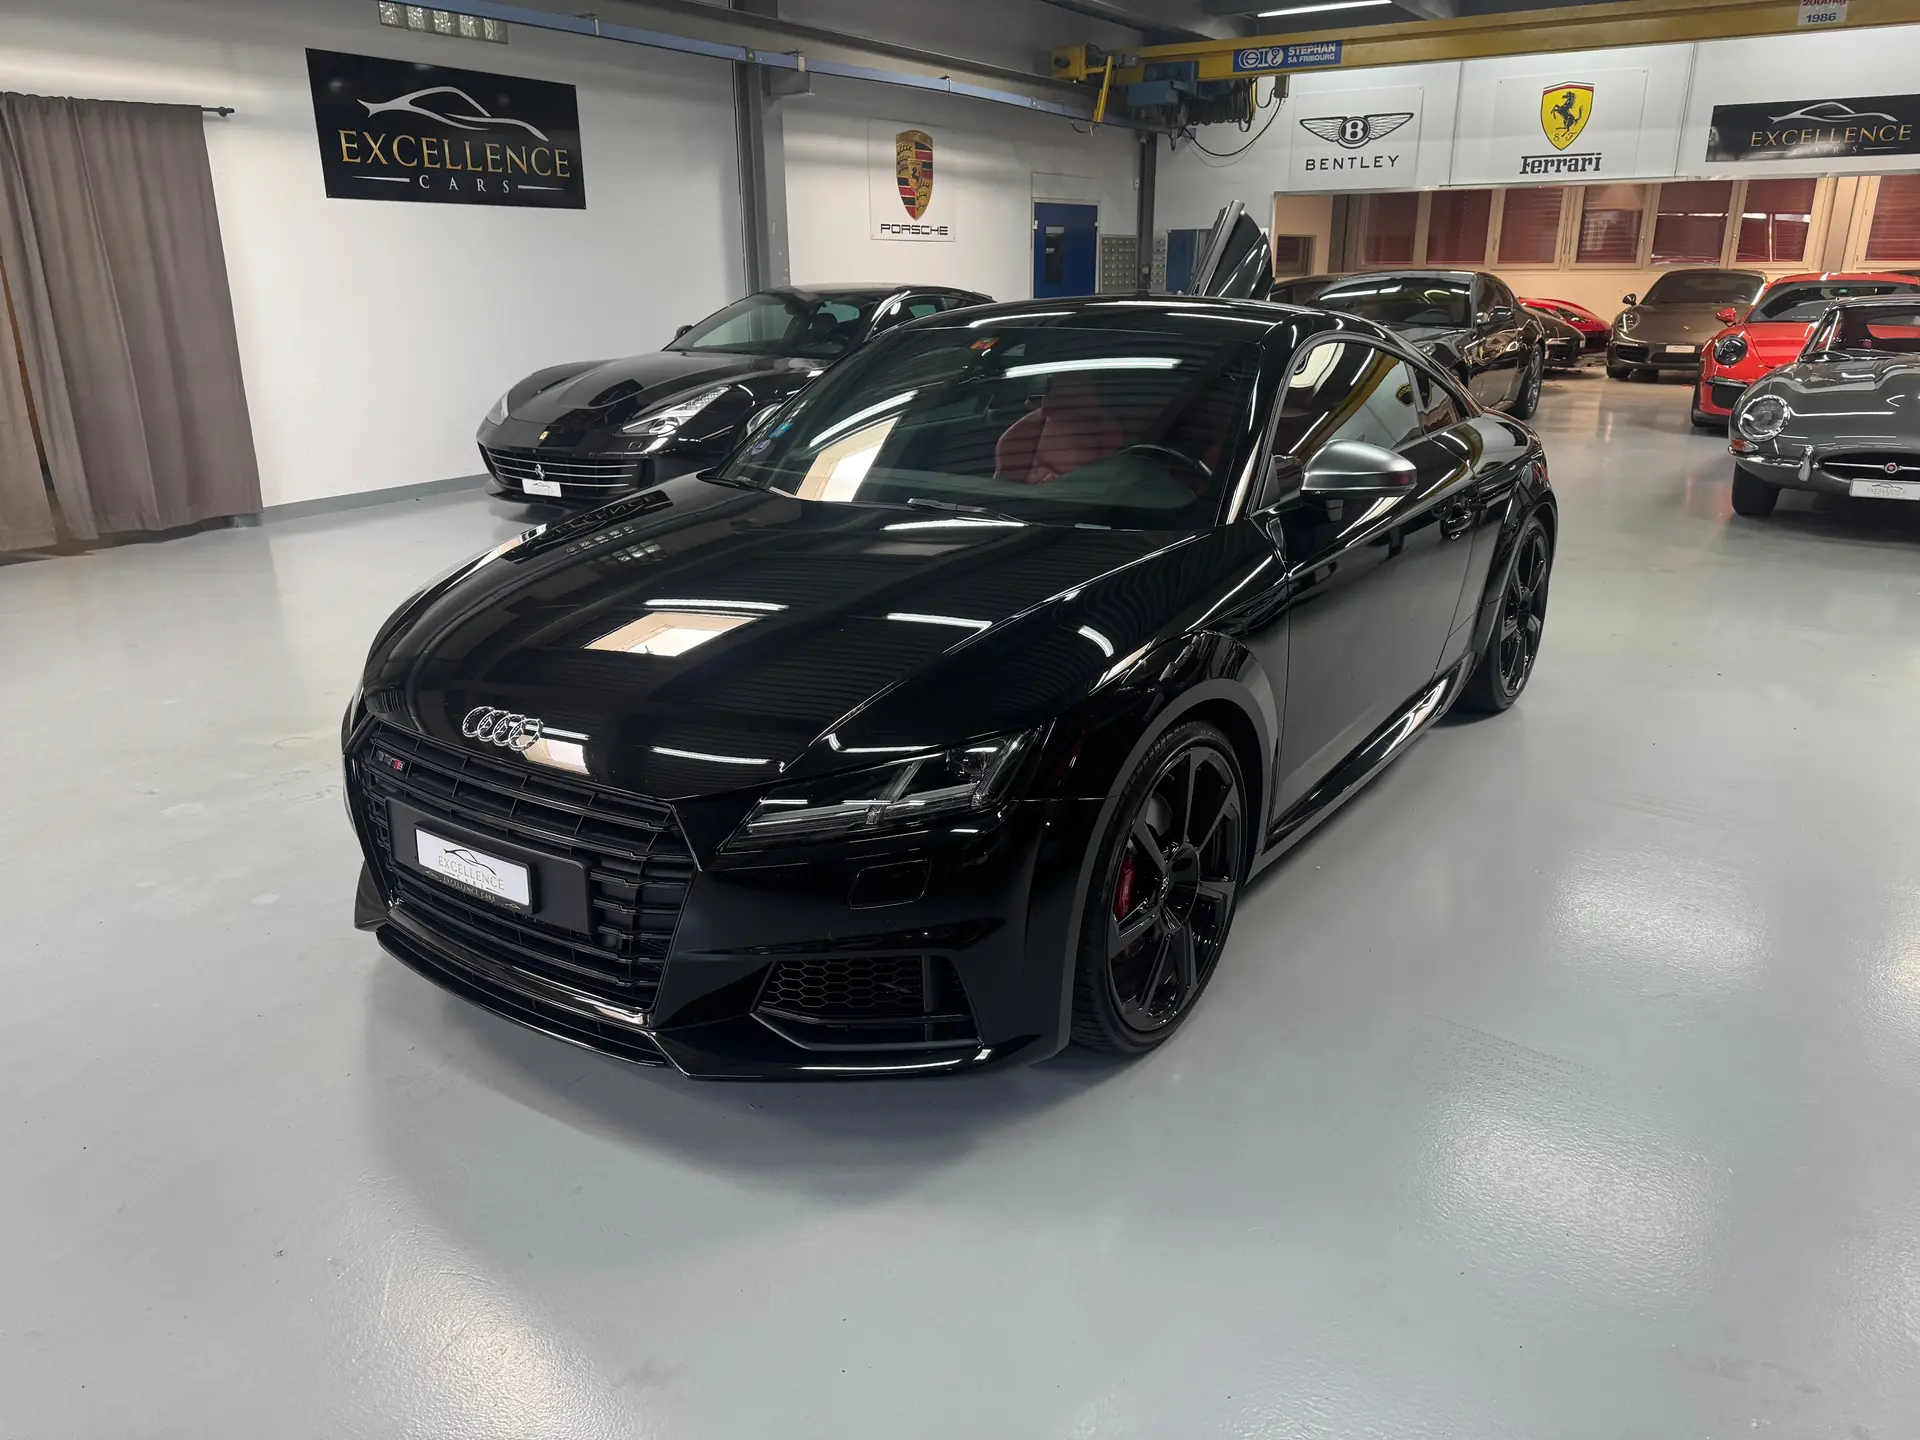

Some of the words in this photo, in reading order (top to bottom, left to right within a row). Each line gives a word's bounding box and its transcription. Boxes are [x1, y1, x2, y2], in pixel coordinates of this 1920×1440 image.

[1806, 12, 1837, 23] 1986
[1288, 43, 1336, 56] STEPHAN
[1299, 53, 1335, 62] FRIBOURG
[1750, 124, 1913, 147] EXCELLENCE
[337, 129, 571, 178] EXCELLENCE
[1793, 145, 1858, 154] CARS
[1305, 155, 1399, 170] BENTLEY
[1519, 152, 1602, 174] Ferrari
[419, 174, 509, 193] CARS
[880, 223, 948, 236] PORSCHE
[437, 855, 505, 891] EXCELLENCE
